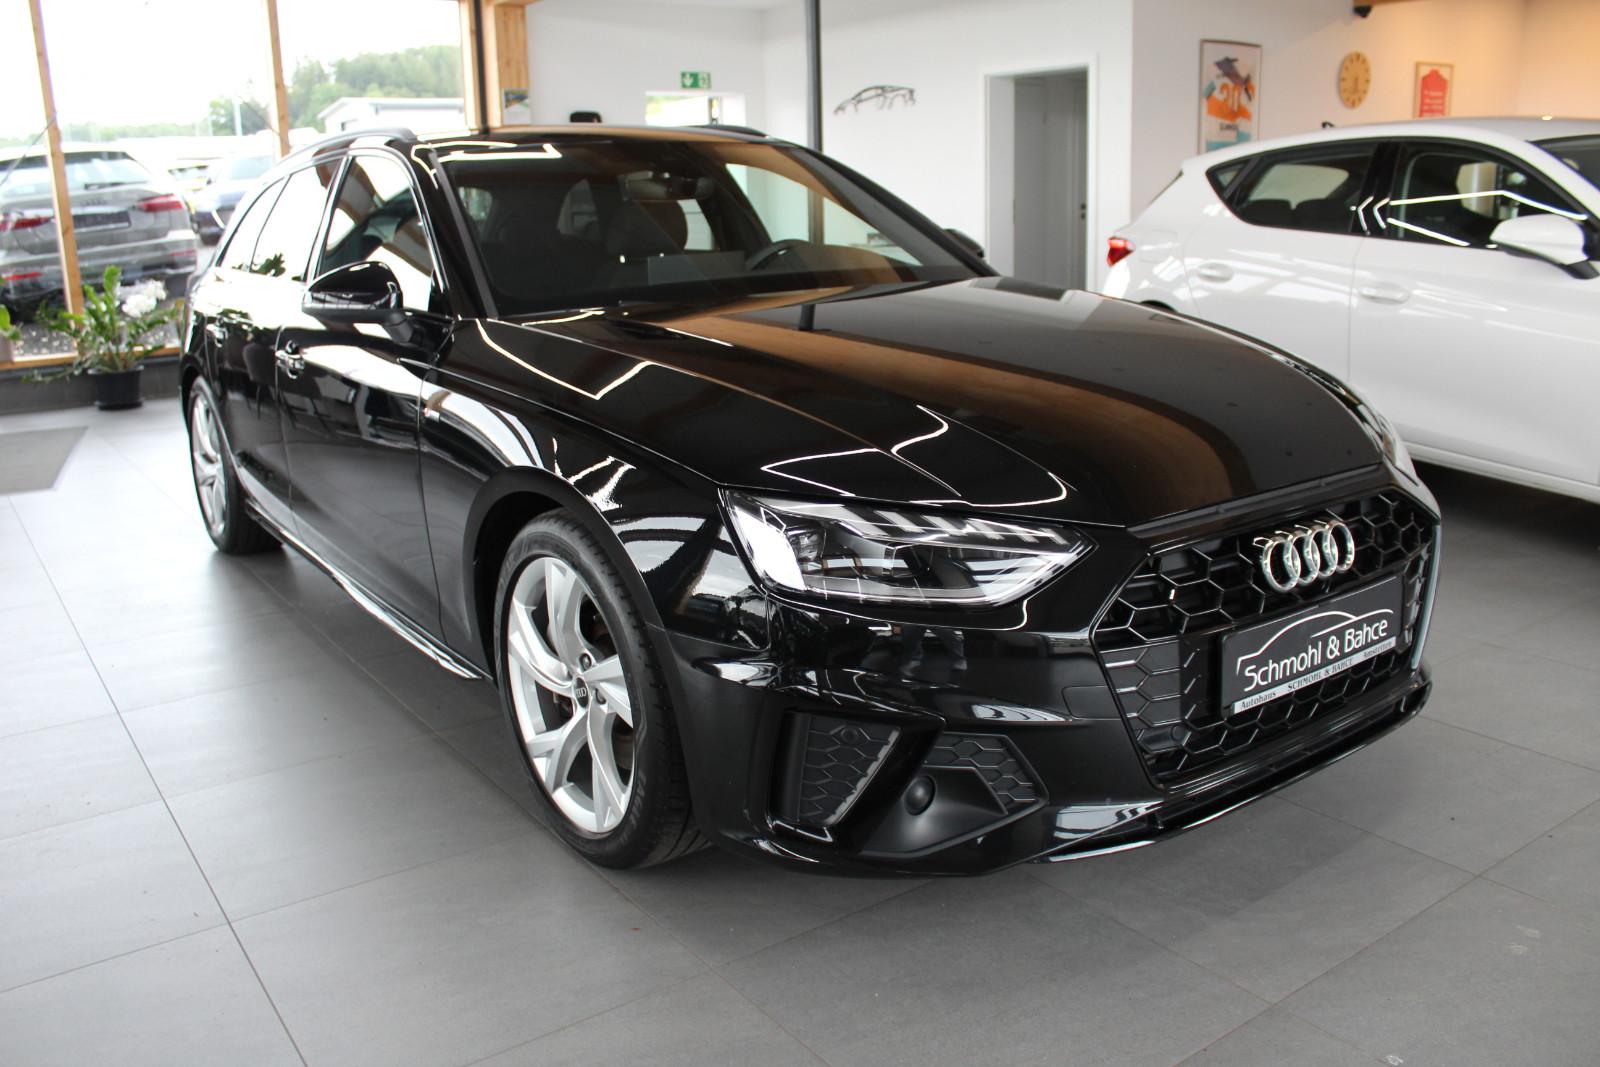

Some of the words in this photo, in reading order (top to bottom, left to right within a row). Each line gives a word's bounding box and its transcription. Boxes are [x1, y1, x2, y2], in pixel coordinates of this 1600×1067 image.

[1244, 641, 1322, 692] Schmohl
[1326, 635, 1341, 660] &
[1344, 619, 1388, 651] Bahce
[1239, 691, 1277, 709] Autohaus
[1287, 671, 1323, 691] SCHMOHL
[1324, 667, 1332, 676] &
